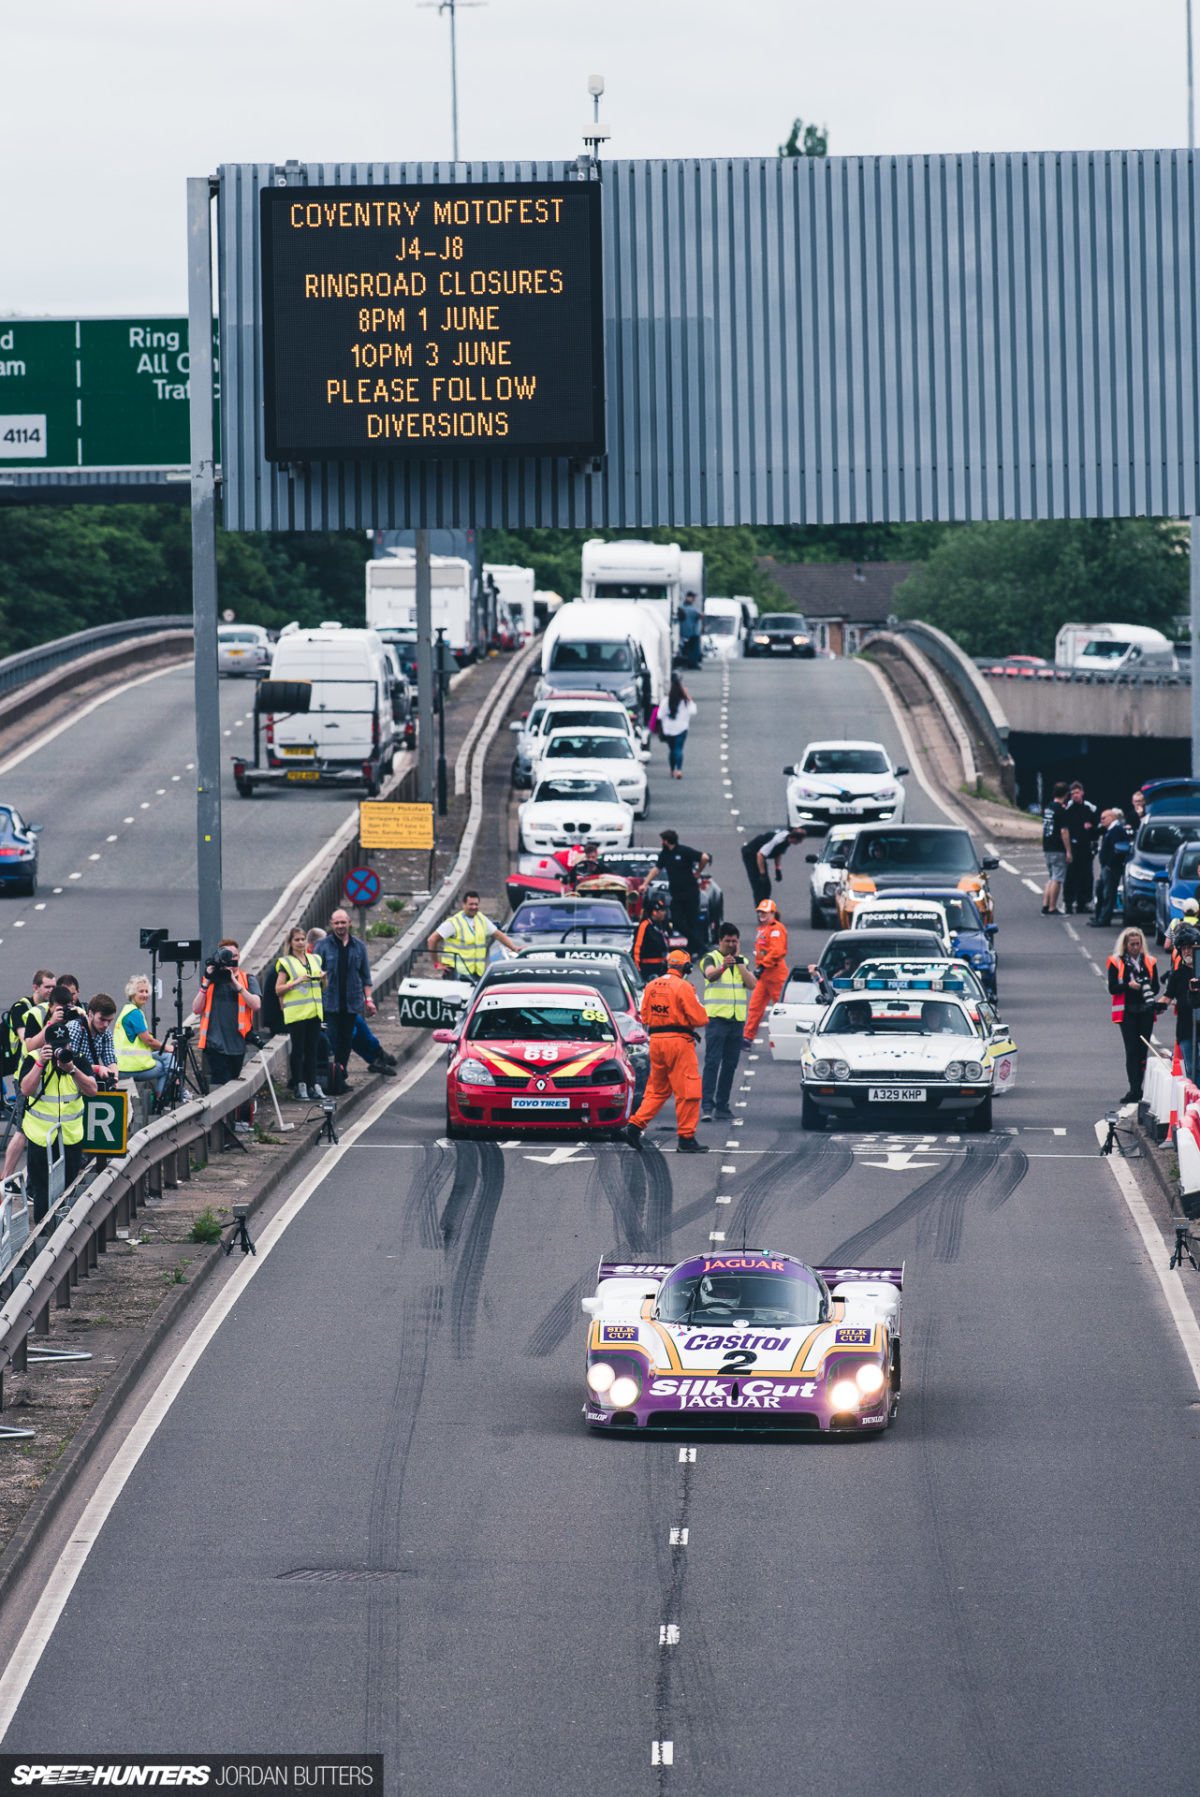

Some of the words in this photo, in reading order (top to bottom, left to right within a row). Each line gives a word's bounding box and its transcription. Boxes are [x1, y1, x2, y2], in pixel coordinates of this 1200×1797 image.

[291, 201, 420, 227] COVENTRY
[434, 199, 564, 225] MOTOFEST
[305, 272, 427, 298] RINGROAD
[439, 269, 563, 295] CLOSURES
[359, 307, 405, 332] 8PM
[418, 307, 427, 331] 1
[440, 306, 499, 331] JUNE
[129, 327, 180, 351] Ring
[351, 343, 412, 367] 10PM
[426, 342, 438, 366] 3
[452, 341, 511, 366] JUNE
[136, 353, 169, 374] All
[327, 378, 420, 403] PLEASE
[432, 375, 536, 401] FOLLOW
[367, 412, 509, 438] DIVERSIONS
[565, 951, 621, 962] JAGUAR
[505, 968, 601, 976] JAGUAR
[903, 963, 932, 971] Sport
[888, 981, 908, 989] POLICE
[582, 1009, 609, 1023] 69
[651, 1004, 669, 1014] NGK
[523, 1049, 559, 1061] 69
[873, 1089, 900, 1100] A329
[902, 1089, 922, 1100] KHP
[513, 1099, 540, 1107] TOYO
[540, 1099, 568, 1107] TIRES
[87, 1101, 116, 1141] R
[702, 1259, 785, 1273] JAGUAR
[836, 1268, 893, 1278] Cut
[684, 1333, 791, 1351] Castrol
[717, 1350, 757, 1375] 2
[649, 1380, 731, 1396] Silk
[742, 1380, 817, 1397] Cut
[679, 1396, 781, 1410] JAGUAR
[862, 1416, 884, 1425] DUNLOP
